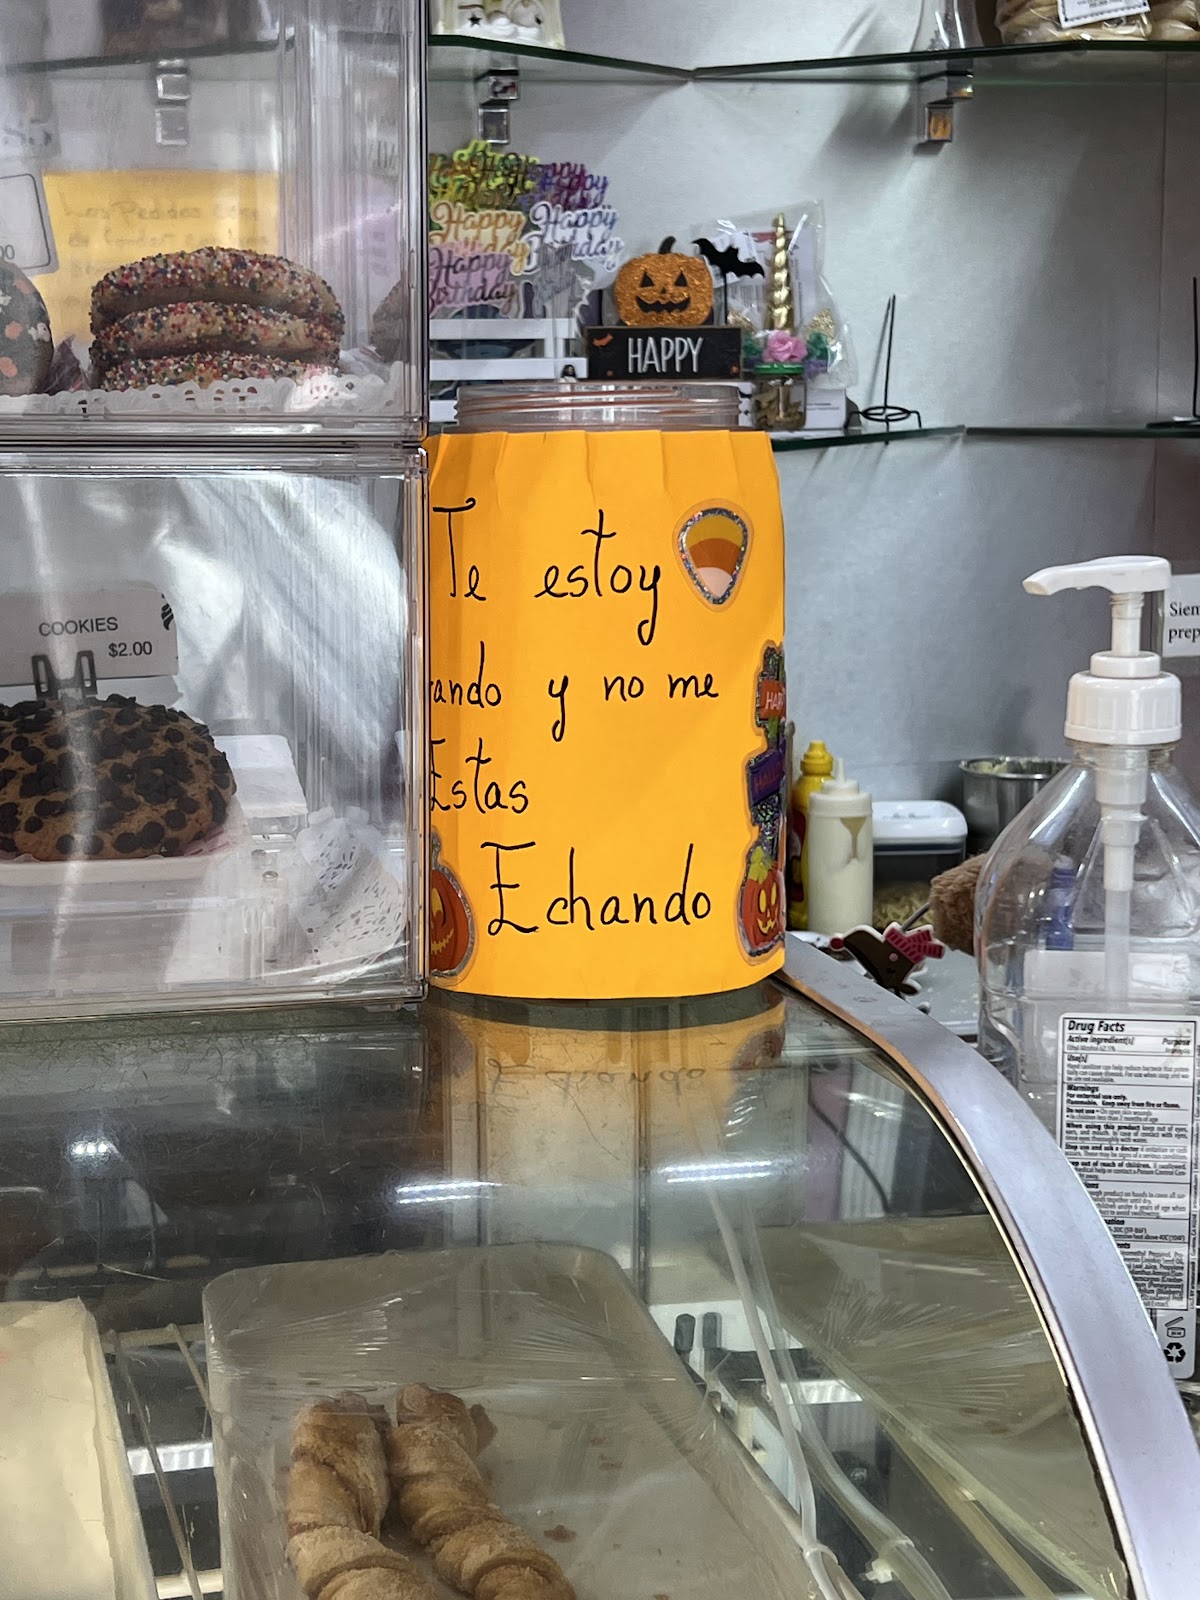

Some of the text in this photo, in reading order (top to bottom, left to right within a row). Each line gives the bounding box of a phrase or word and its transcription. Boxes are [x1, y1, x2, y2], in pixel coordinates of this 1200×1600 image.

[437, 204, 525, 246] Happy
[532, 205, 618, 246] Happy
[628, 336, 703, 374] HAPPY
[433, 497, 661, 646] Te estoy
[39, 616, 119, 637] COOKIES
[108, 641, 153, 658] $2.00
[430, 641, 719, 742] ando y no me
[431, 738, 529, 814] Estas
[481, 841, 711, 936] Echando
[1067, 1035, 1089, 1043] Active
[1162, 1037, 1191, 1047] Purpose
[1068, 1020, 1126, 1034] Drug Facts
[1067, 1084, 1099, 1093] Warnings
